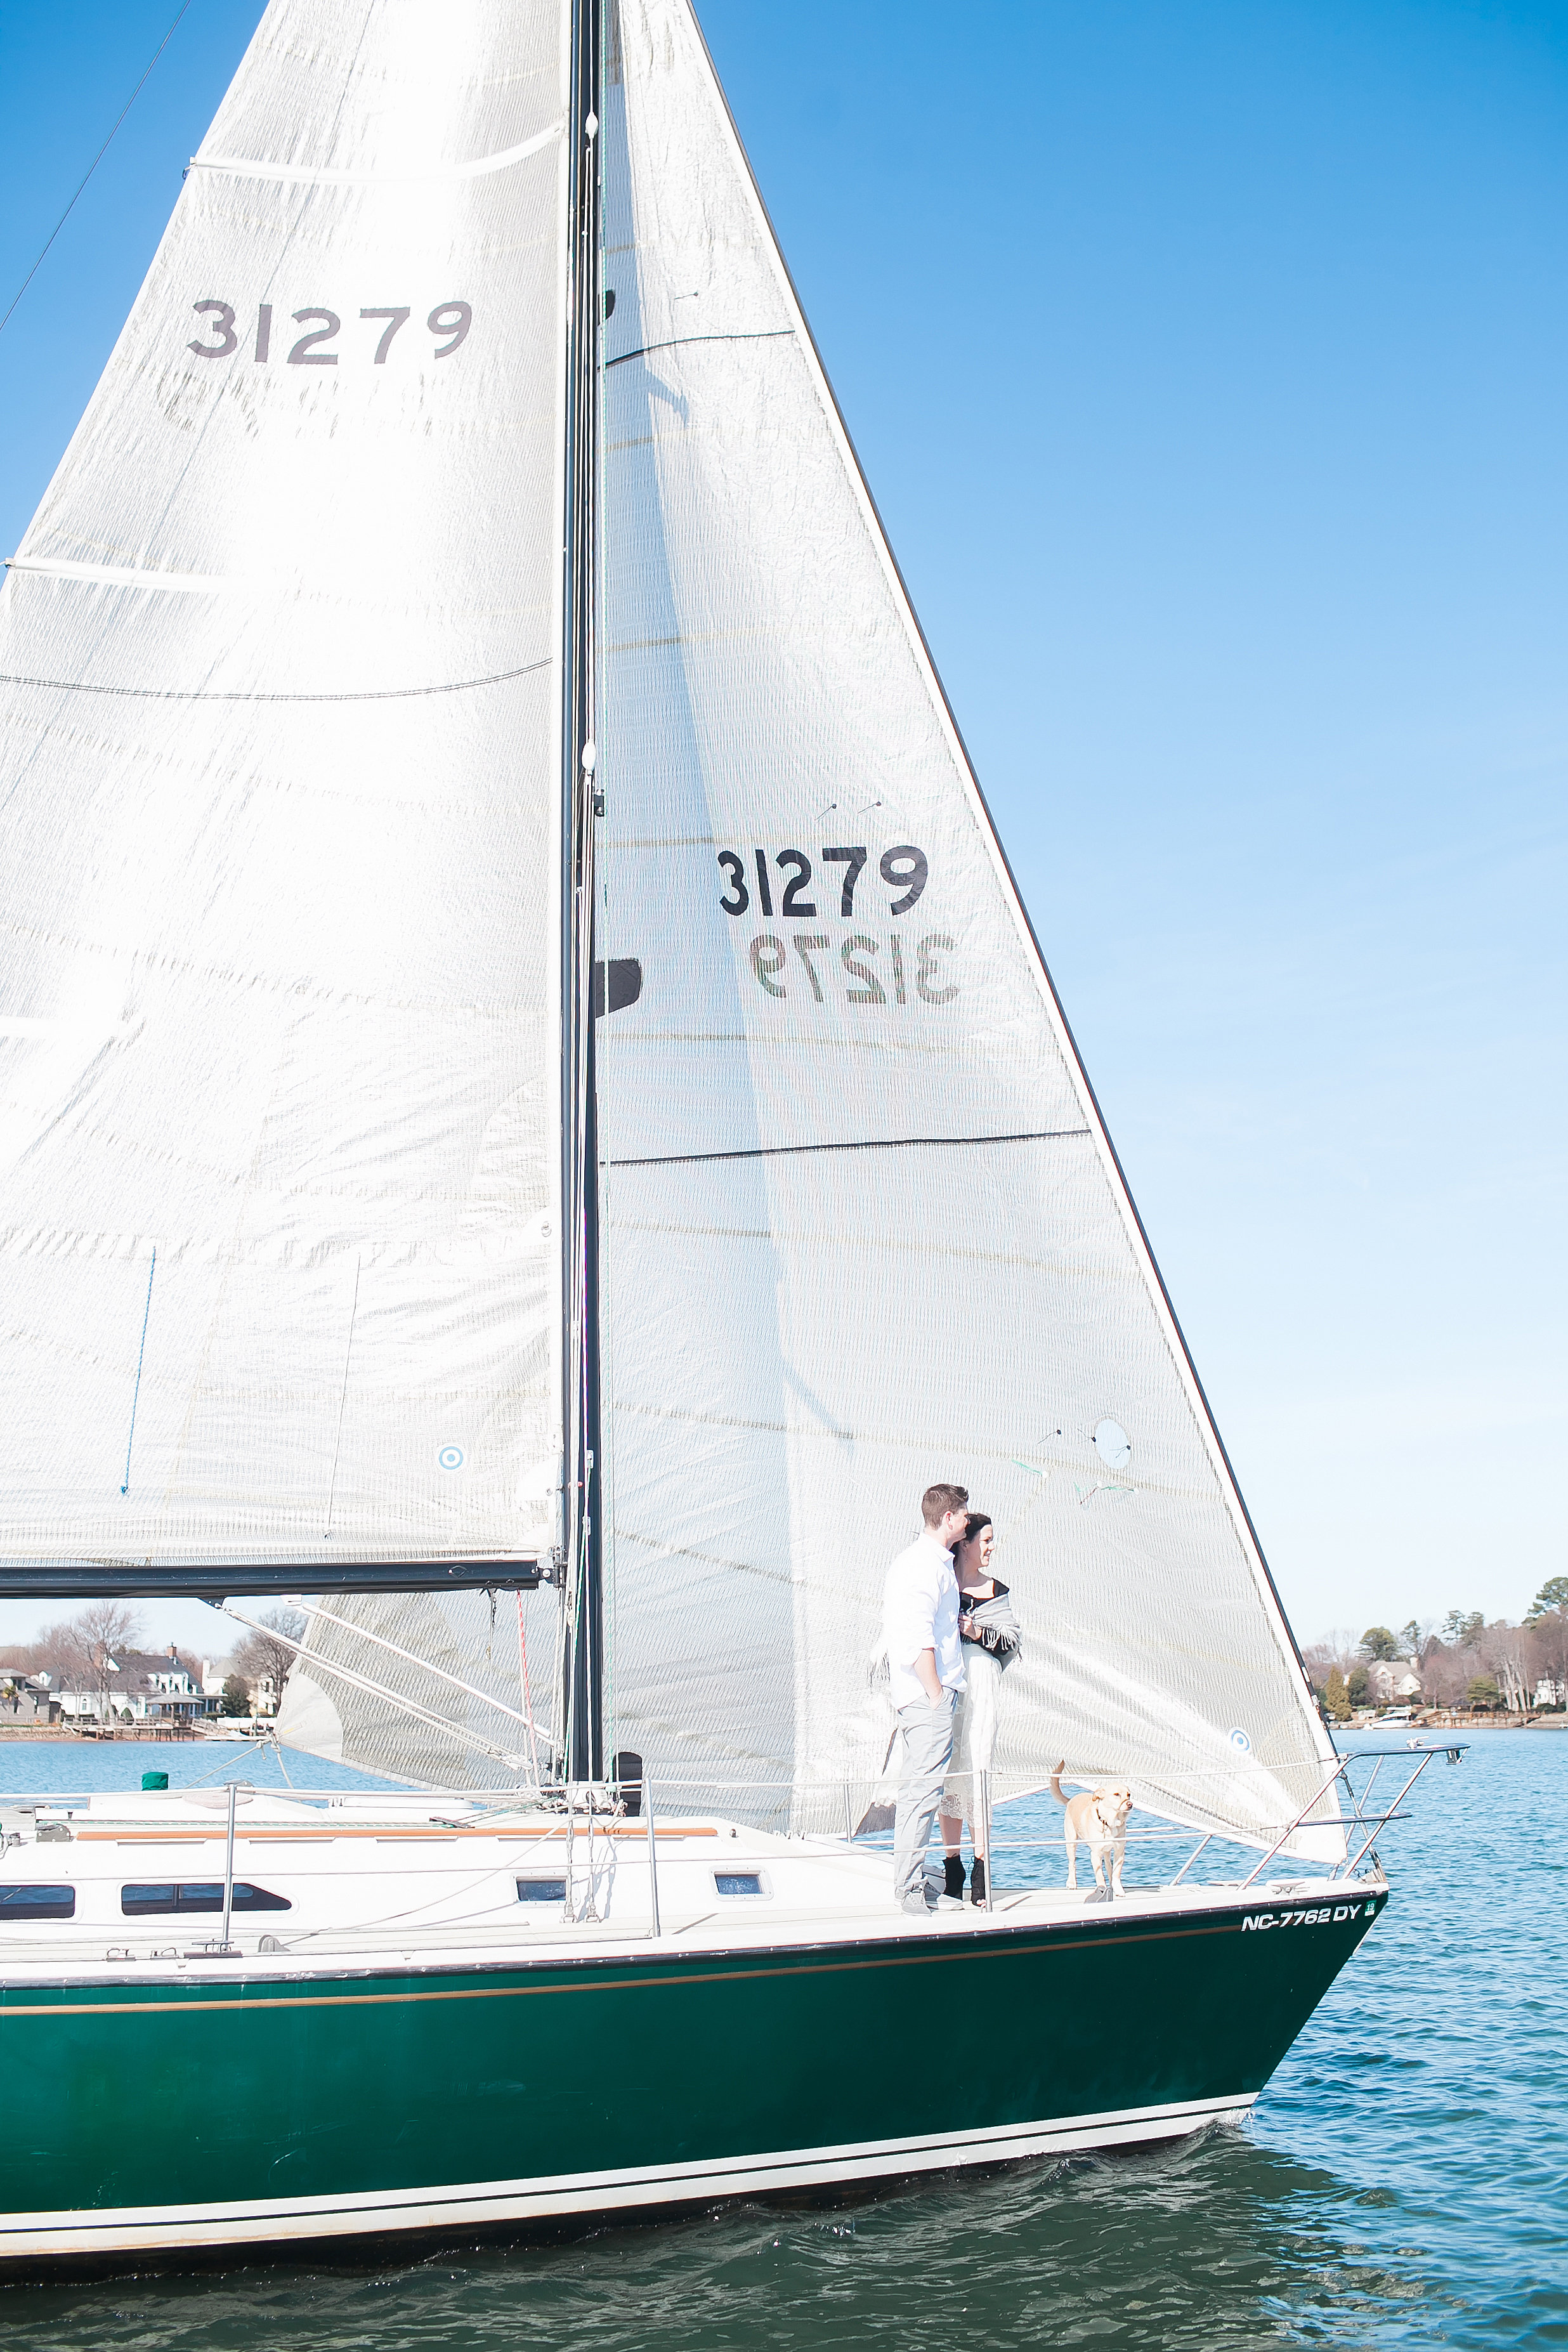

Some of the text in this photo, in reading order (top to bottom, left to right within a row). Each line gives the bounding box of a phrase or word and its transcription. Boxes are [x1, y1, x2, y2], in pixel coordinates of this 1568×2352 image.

[187, 299, 472, 365] 31279
[717, 846, 928, 917] 31279
[1241, 1904, 1362, 1931] NC-7762 DY
